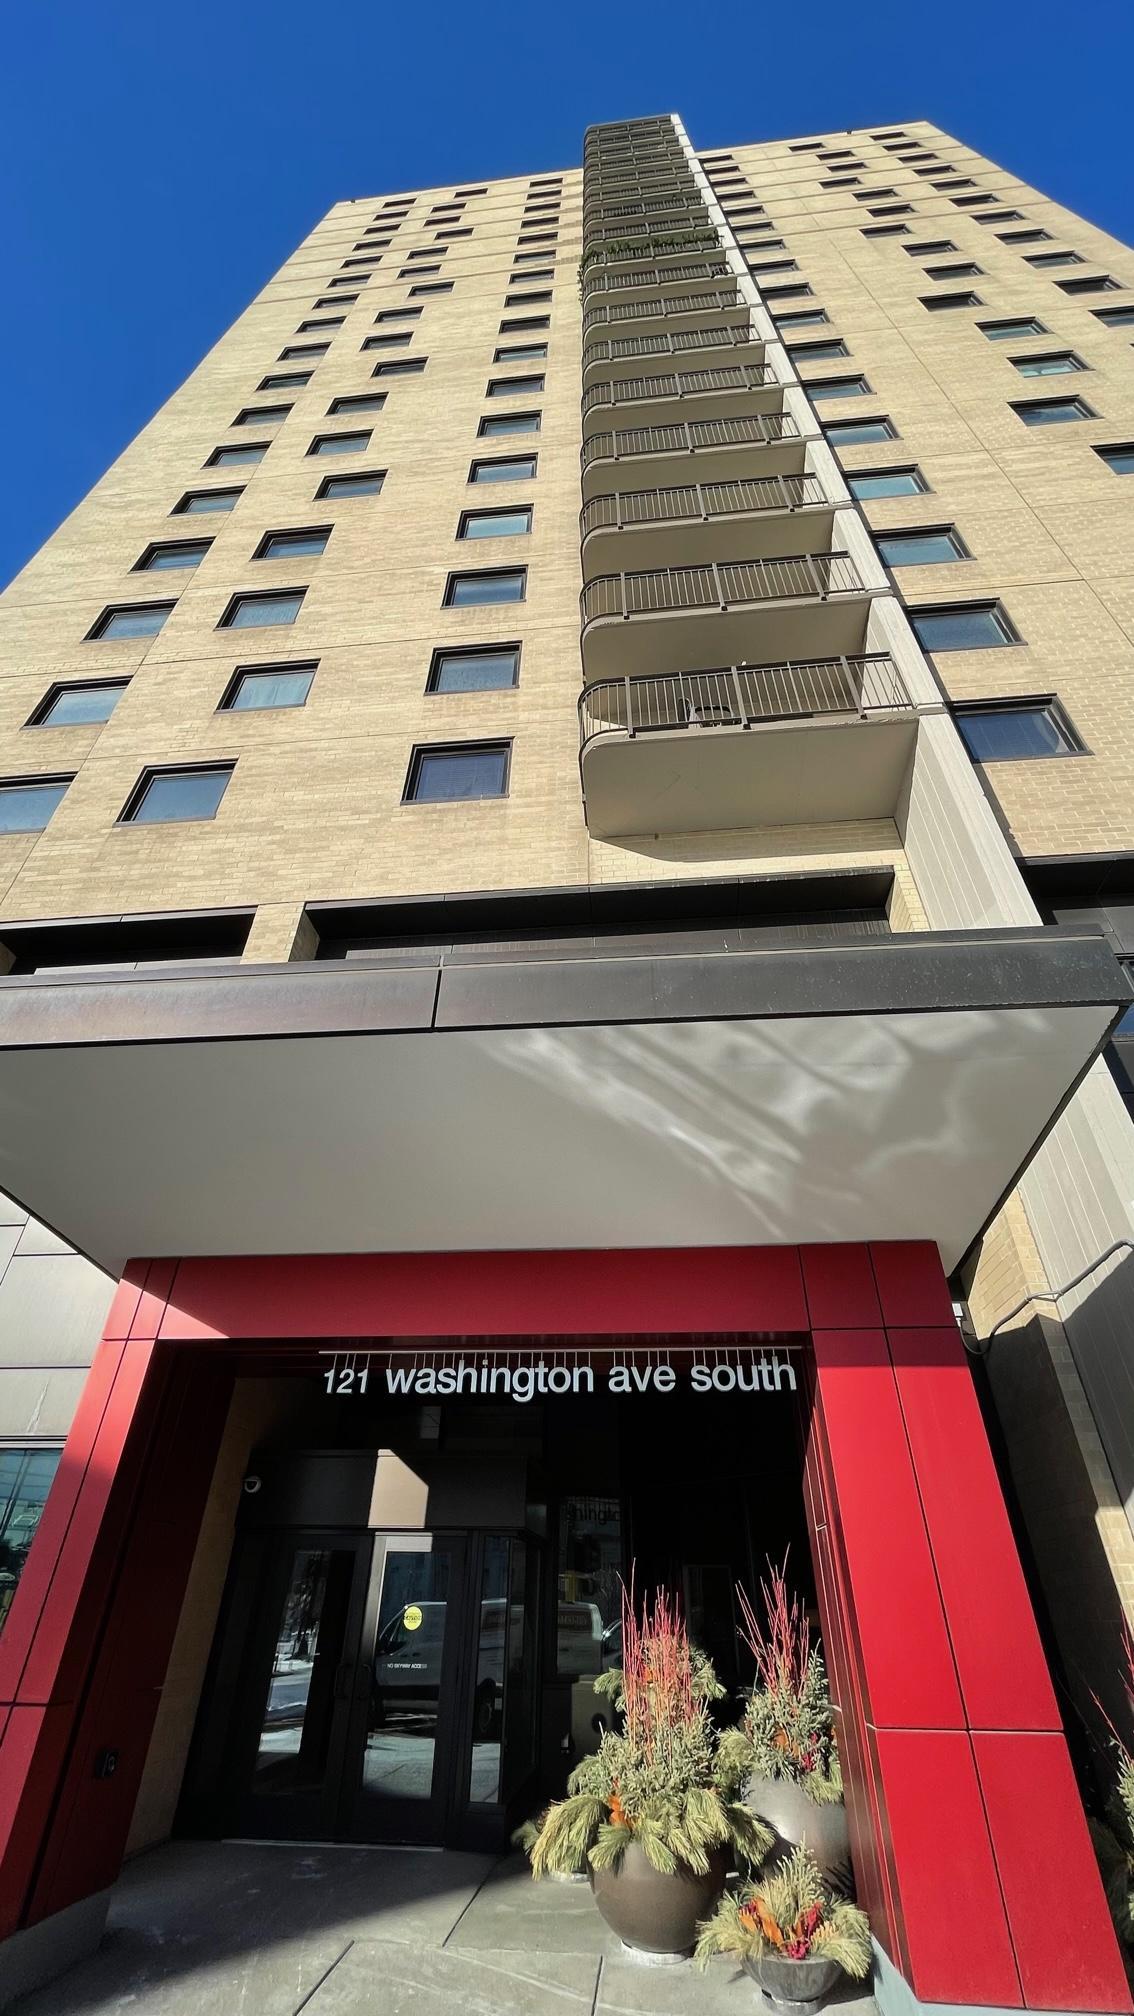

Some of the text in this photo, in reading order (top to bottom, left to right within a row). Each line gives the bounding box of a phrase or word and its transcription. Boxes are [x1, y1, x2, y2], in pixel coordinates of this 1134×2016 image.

[323, 1356, 797, 1402] 121 washington ave south
